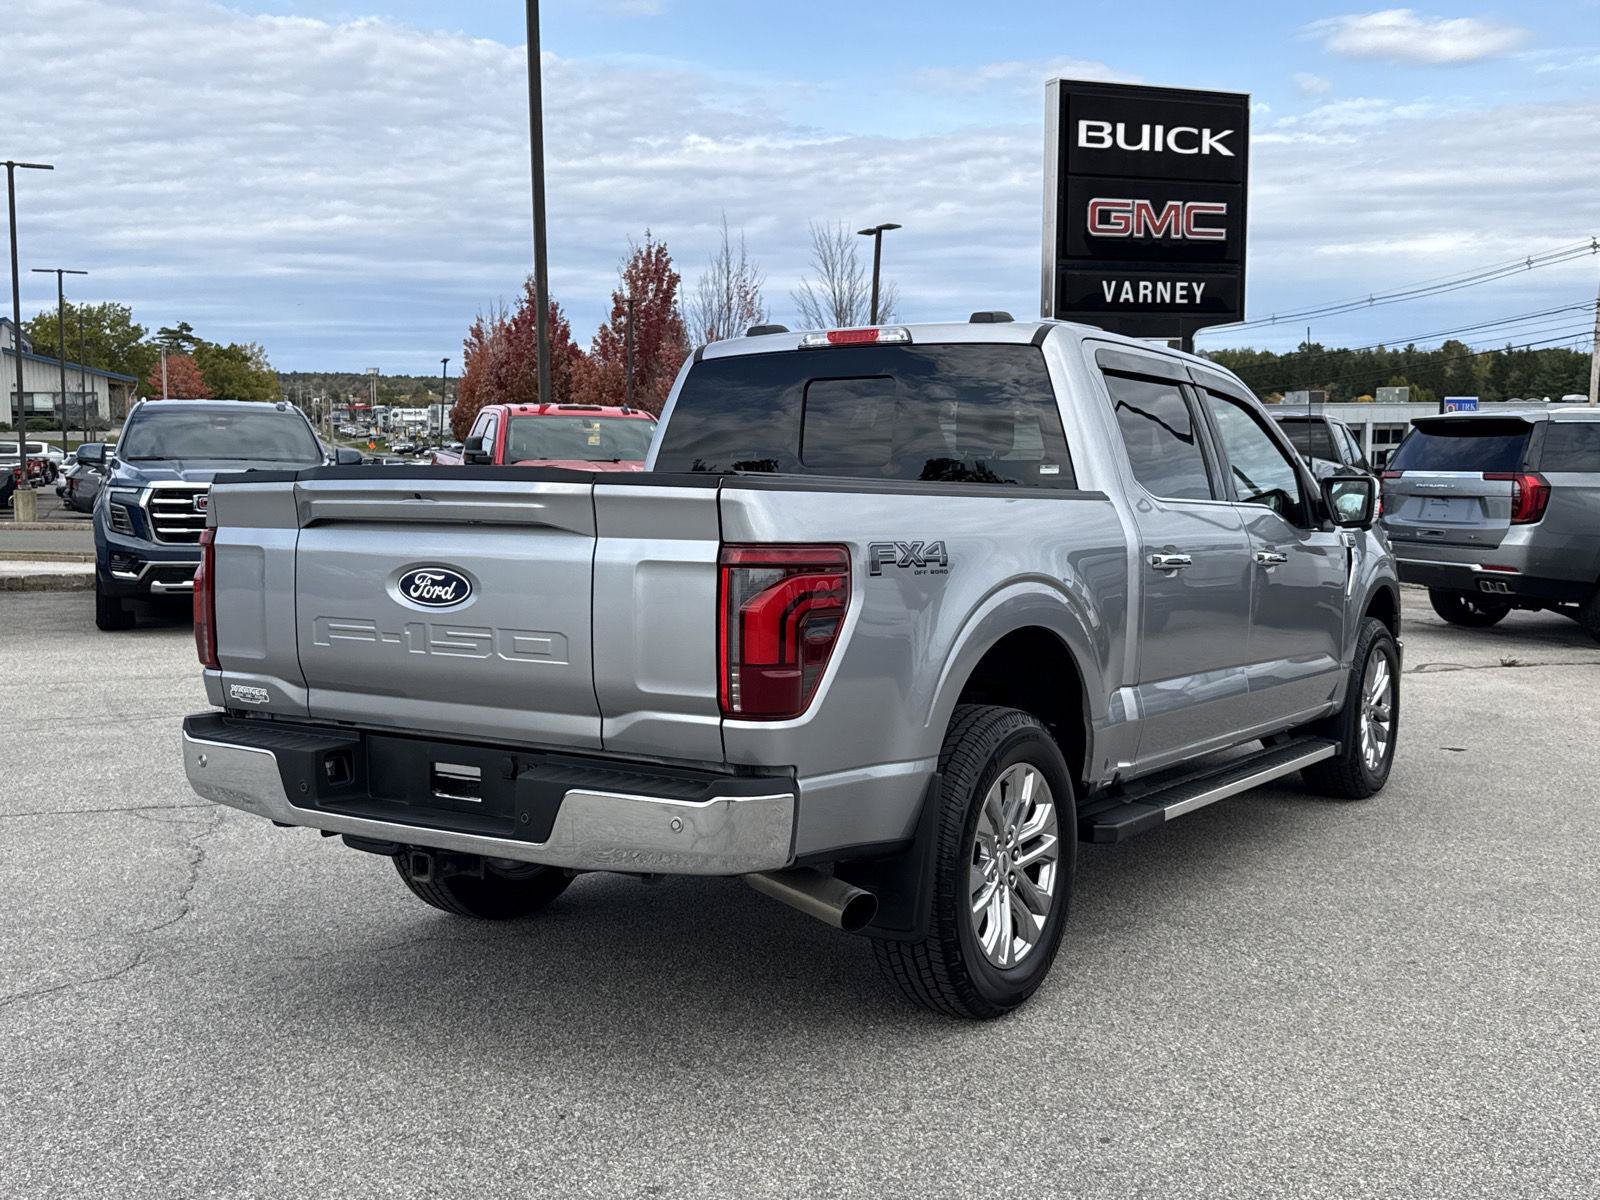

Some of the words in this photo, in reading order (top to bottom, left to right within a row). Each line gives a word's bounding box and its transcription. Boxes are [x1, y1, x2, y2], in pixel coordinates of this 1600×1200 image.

[1077, 119, 1236, 157] BUICK
[1087, 197, 1228, 241] GMC
[1101, 280, 1206, 305] VARNEY
[868, 541, 949, 576] FX4
[409, 572, 457, 599] Ford
[312, 615, 569, 665] F-150
